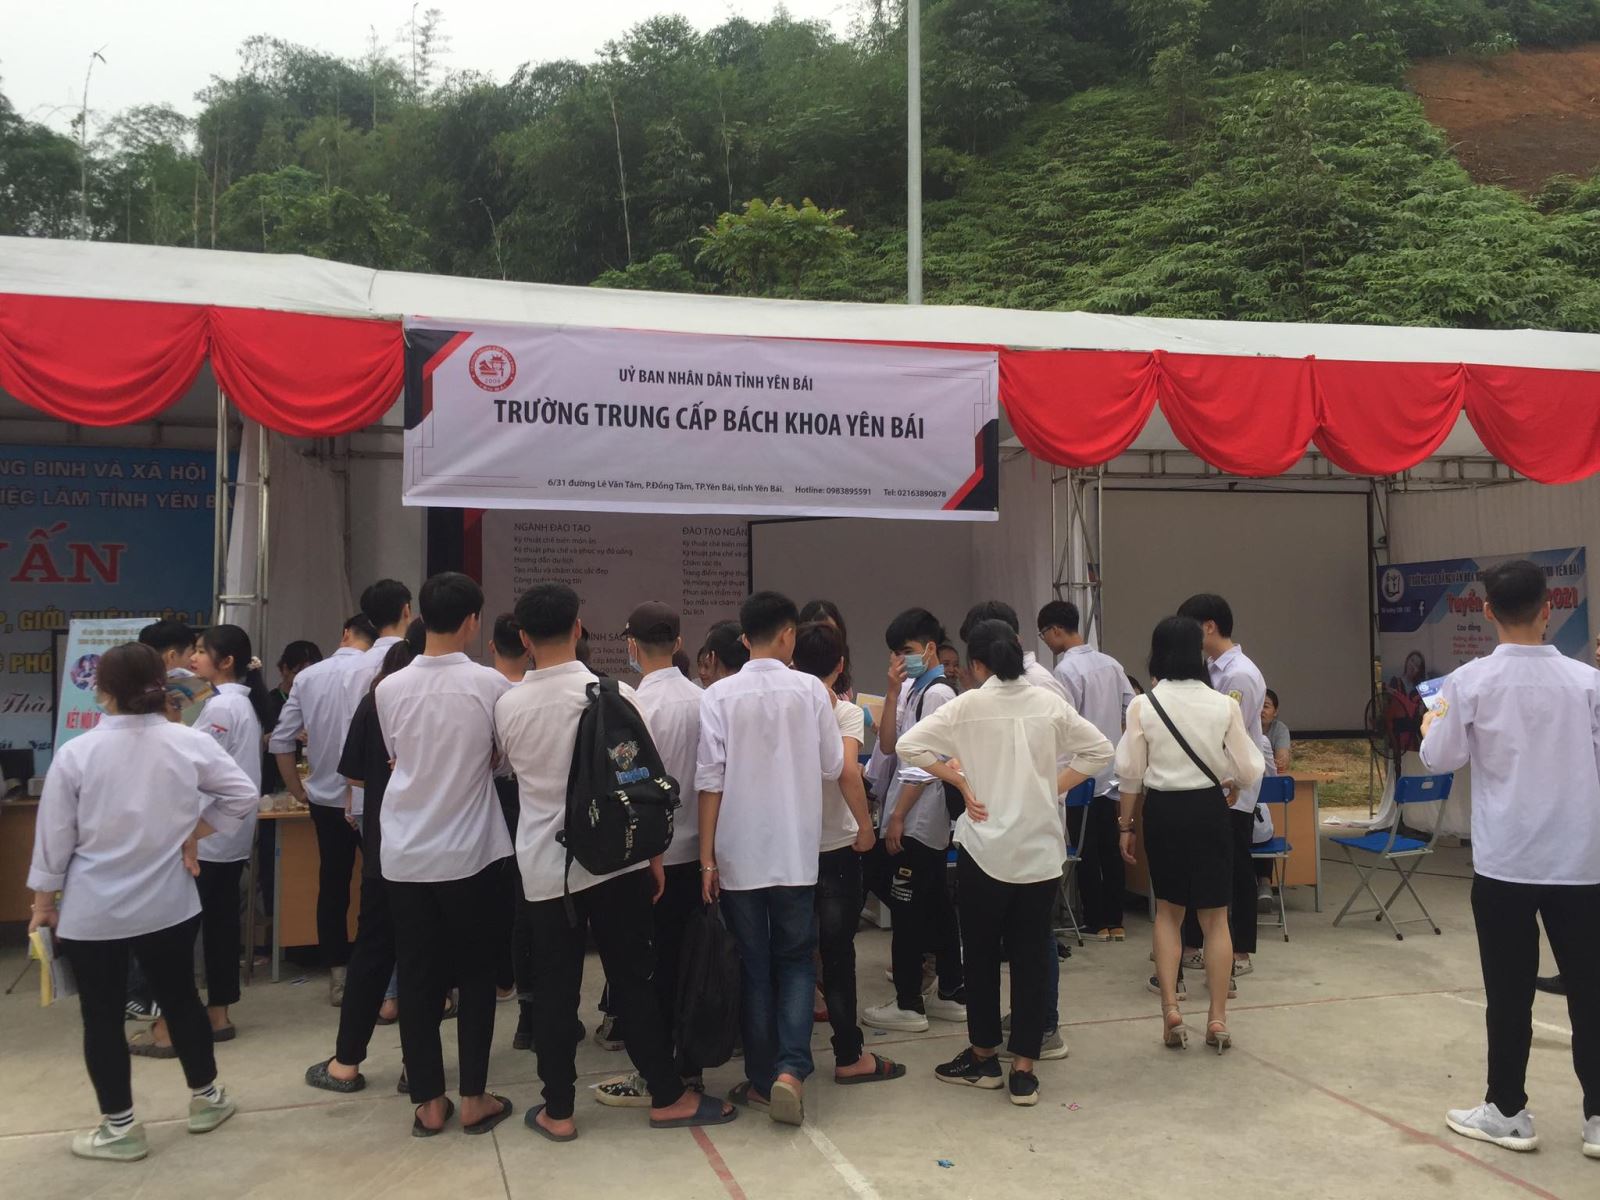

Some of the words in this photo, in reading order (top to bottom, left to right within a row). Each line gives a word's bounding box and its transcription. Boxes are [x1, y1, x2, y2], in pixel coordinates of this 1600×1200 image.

[639, 370, 665, 384] BAN
[668, 369, 704, 386] NHÂN
[707, 371, 732, 388] DÂN
[734, 371, 764, 389] TỈNH
[767, 374, 790, 390] YÊN
[793, 375, 814, 391] BÁI
[493, 396, 589, 426] TRƯỜNG
[594, 403, 671, 429] TRUNG
[675, 400, 718, 432] CẤP
[723, 406, 779, 434] BÁCH
[785, 411, 842, 436] KHOA
[846, 410, 885, 437] YÊN
[891, 412, 925, 440] BÁI
[93, 458, 123, 478] VÀ
[131, 460, 162, 480] XÃ
[169, 462, 207, 485] HỘI
[156, 489, 198, 509] YÊN
[547, 478, 566, 487] 6/31
[568, 480, 596, 489] đường
[795, 486, 825, 494] Hotline:
[884, 488, 897, 496] Tel:
[0, 520, 126, 583] ẤN
